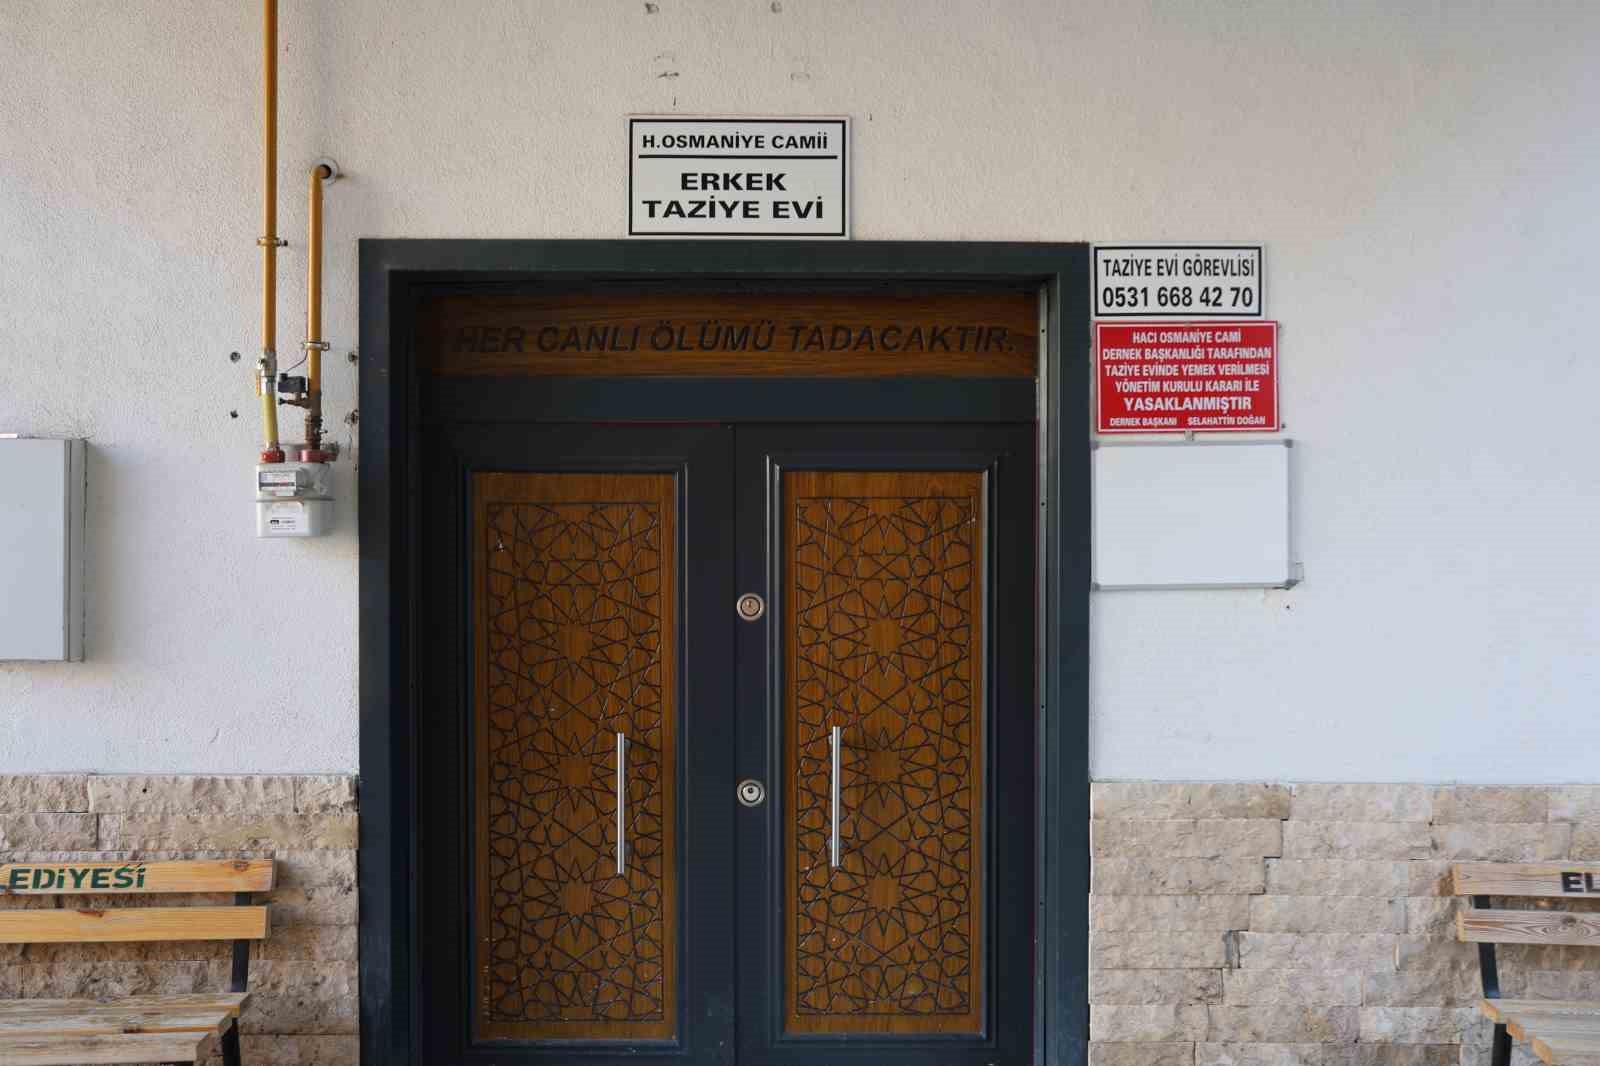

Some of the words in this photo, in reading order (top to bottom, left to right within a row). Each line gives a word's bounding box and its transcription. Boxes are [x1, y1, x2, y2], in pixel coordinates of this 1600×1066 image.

[642, 131, 765, 149] H.OSMANİYE
[771, 132, 828, 149] CAMİİ
[681, 173, 787, 191] ERKEK
[642, 195, 760, 218] TAZİYE
[772, 196, 824, 219] EVİ
[1103, 253, 1152, 277] TAZİYE
[1156, 253, 1179, 277] EVİ
[1183, 253, 1255, 277] GÖREVLİSİ
[1103, 286, 1149, 307] 0531
[1157, 286, 1192, 307] 668
[1200, 286, 1223, 307] 42
[1230, 286, 1253, 307] 70
[455, 326, 525, 351] HER
[537, 325, 641, 351] CANLI
[650, 320, 775, 351] ÖLÜMÜ
[788, 325, 1015, 351] TADACAKTIR.
[1132, 331, 1158, 343] HACI
[1159, 328, 1213, 343] OSMANİYE
[1214, 328, 1241, 342] CAMİ
[1103, 349, 1142, 360] DERNEK
[1145, 345, 1205, 362] BAŞKANLIĞI
[1207, 347, 1272, 359] TARAFINDAN
[1105, 361, 1140, 376] TAZİYE
[1142, 361, 1180, 376] EVİNDE
[1182, 364, 1216, 375] YEMEK
[1217, 360, 1270, 375] VERİLMESİ
[1115, 378, 1160, 392] YÖNETİM
[1162, 379, 1203, 392] KURULU
[1205, 379, 1243, 392] KARARI
[1244, 377, 1259, 391] İLE
[1124, 397, 1252, 414] YASAKLANMIŞTIR
[1110, 417, 1142, 426] DERNEK
